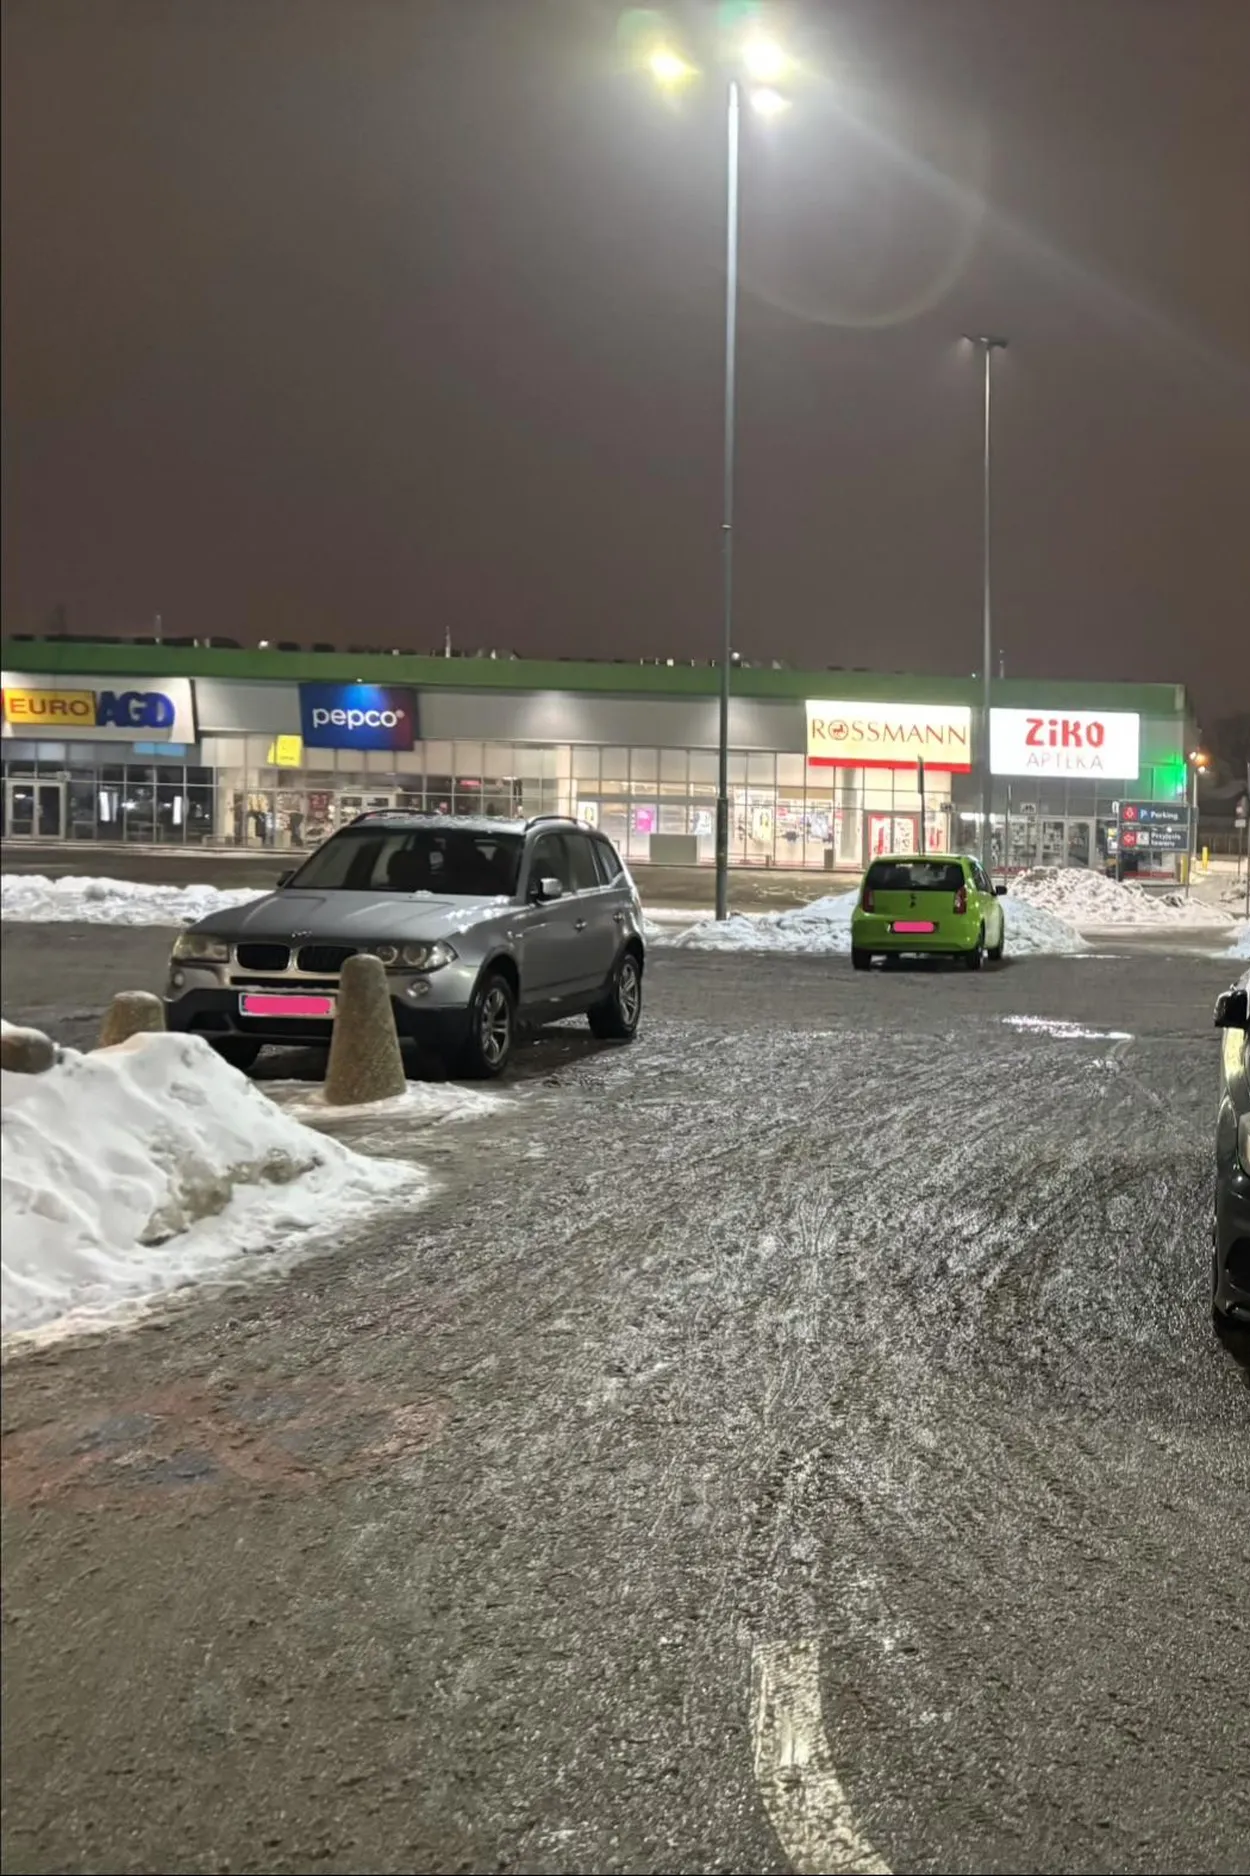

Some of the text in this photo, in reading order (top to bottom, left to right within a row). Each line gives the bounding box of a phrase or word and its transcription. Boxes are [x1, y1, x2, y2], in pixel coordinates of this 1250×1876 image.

[10, 690, 175, 728] EURO AGD
[312, 707, 398, 730] pepco
[811, 718, 967, 745] ROSSMANN
[1150, 810, 1179, 821] Parking
